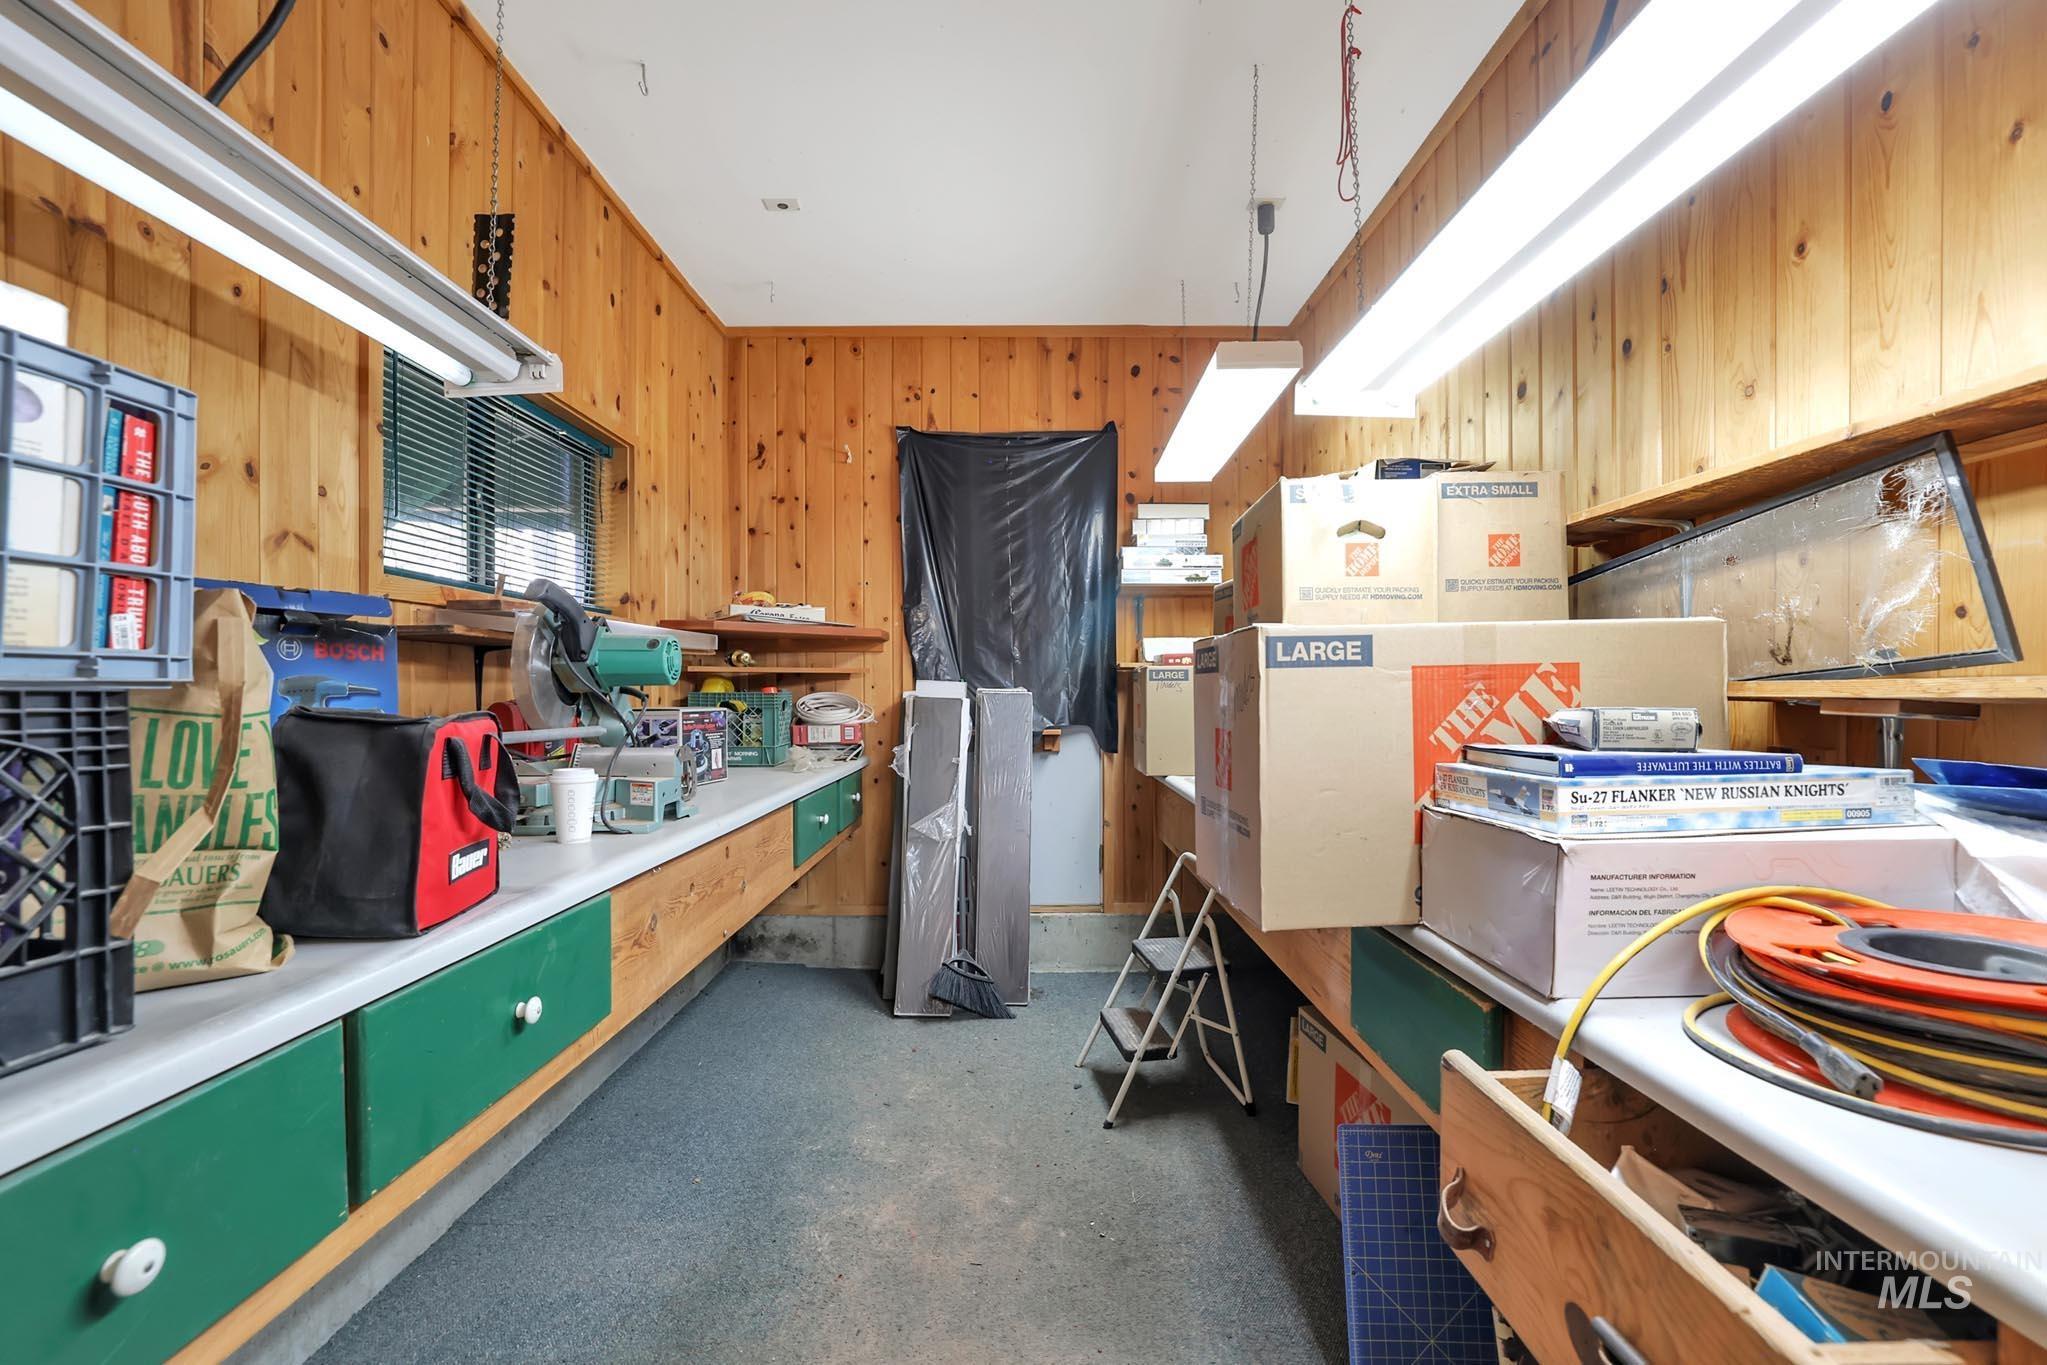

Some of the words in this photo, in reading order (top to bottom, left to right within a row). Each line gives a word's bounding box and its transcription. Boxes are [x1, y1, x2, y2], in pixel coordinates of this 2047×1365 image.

[134, 450, 152, 478] THE
[1446, 485, 1488, 496] EXTRA
[1491, 484, 1533, 495] SMALL
[130, 495, 150, 531] UTH
[129, 534, 148, 564] ABO
[1345, 543, 1379, 576] HOME
[1489, 533, 1520, 567] HOME
[314, 640, 385, 661] BOSCH
[1276, 640, 1362, 662] LARGE
[1152, 671, 1185, 679] LARGE
[1428, 682, 1500, 754] THE
[139, 717, 253, 790] LOVE
[1715, 761, 1742, 770] WITH
[1743, 760, 1782, 770] BATTLES
[1636, 762, 1690, 772] LUFTWAFFE
[1692, 762, 1712, 771] THE
[1571, 791, 1608, 804] Su-27
[1611, 788, 1677, 803] FLANKER
[1721, 785, 1780, 799] RUSSIAN
[1846, 810, 1871, 818] 00905
[160, 862, 241, 888] AUERS
[451, 847, 488, 880] Bauer
[1302, 1018, 1325, 1047] LARGE
